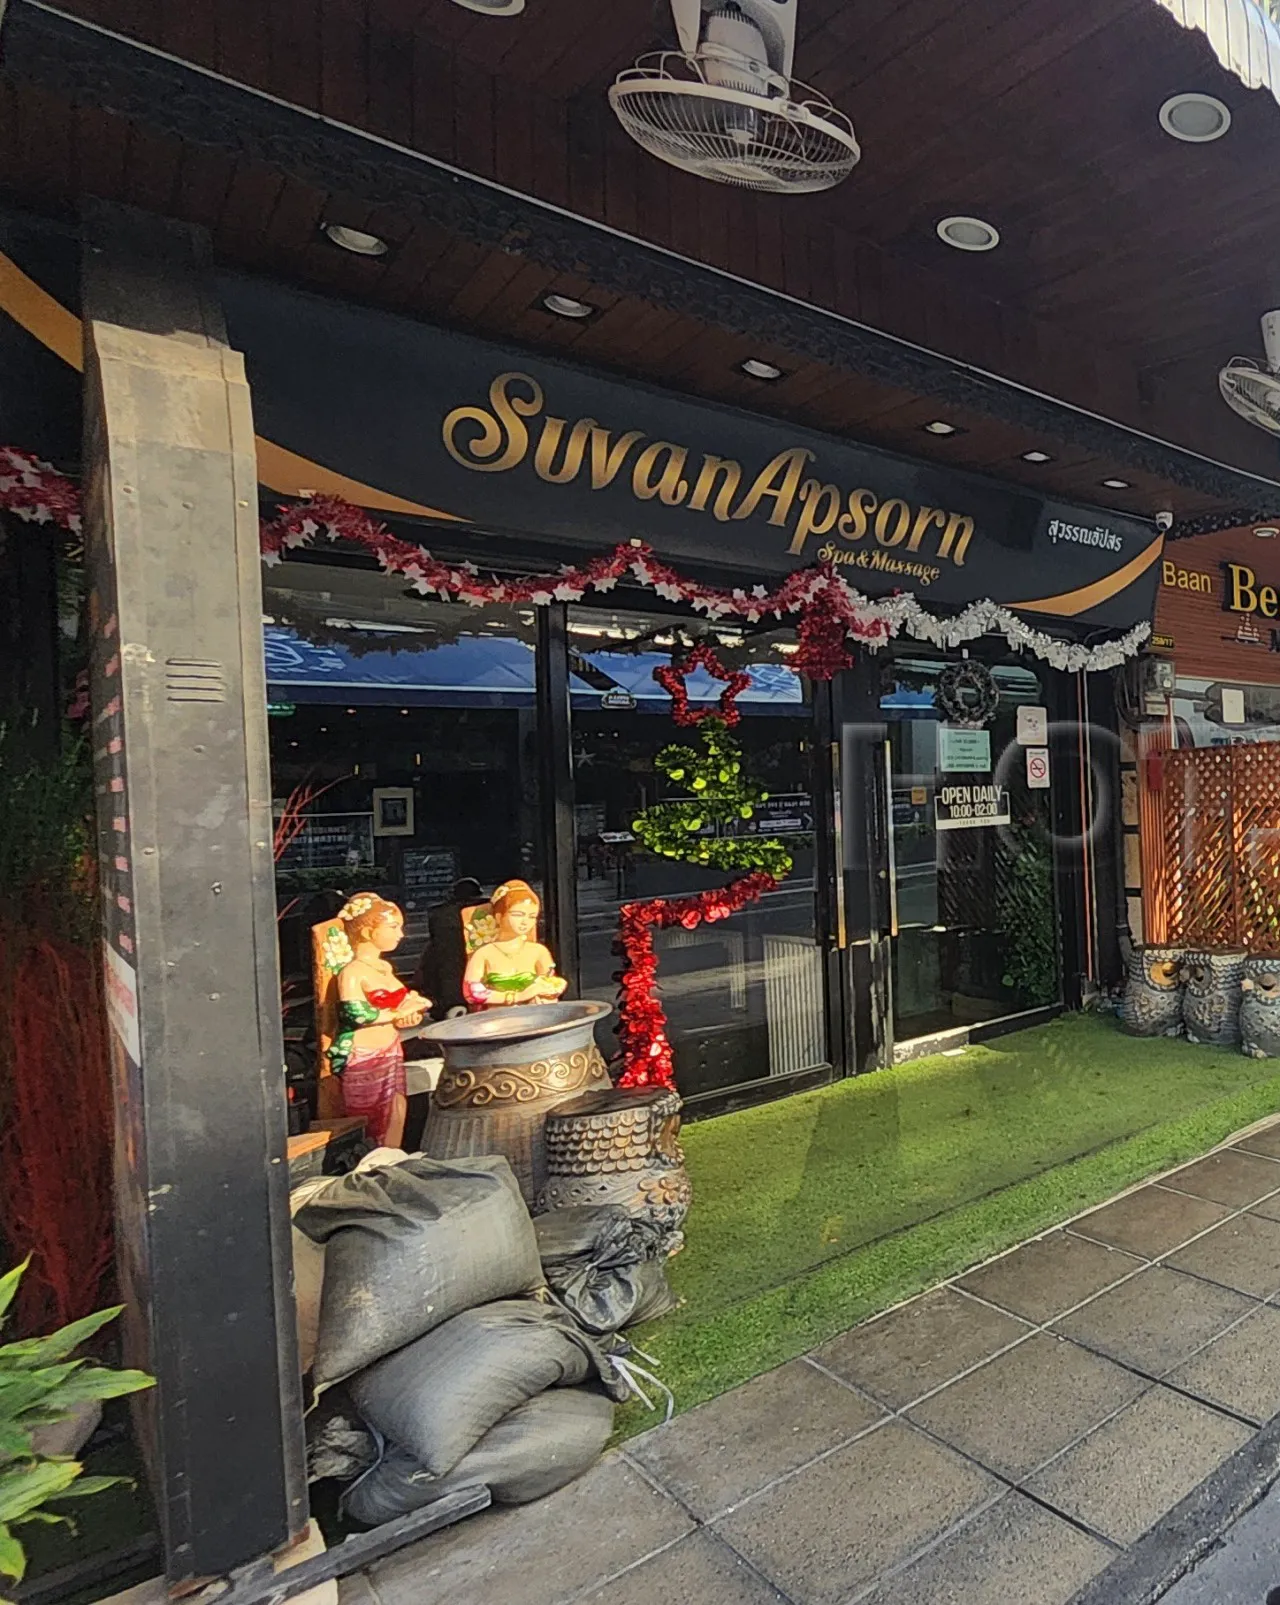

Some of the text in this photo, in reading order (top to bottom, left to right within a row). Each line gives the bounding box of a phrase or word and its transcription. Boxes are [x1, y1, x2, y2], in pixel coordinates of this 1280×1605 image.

[442, 372, 976, 567] SuvanApsorn
[1048, 519, 1123, 552] สุวรรณอัปสร
[1162, 560, 1213, 594] Baan
[941, 784, 1003, 805] OPEN DAILY
